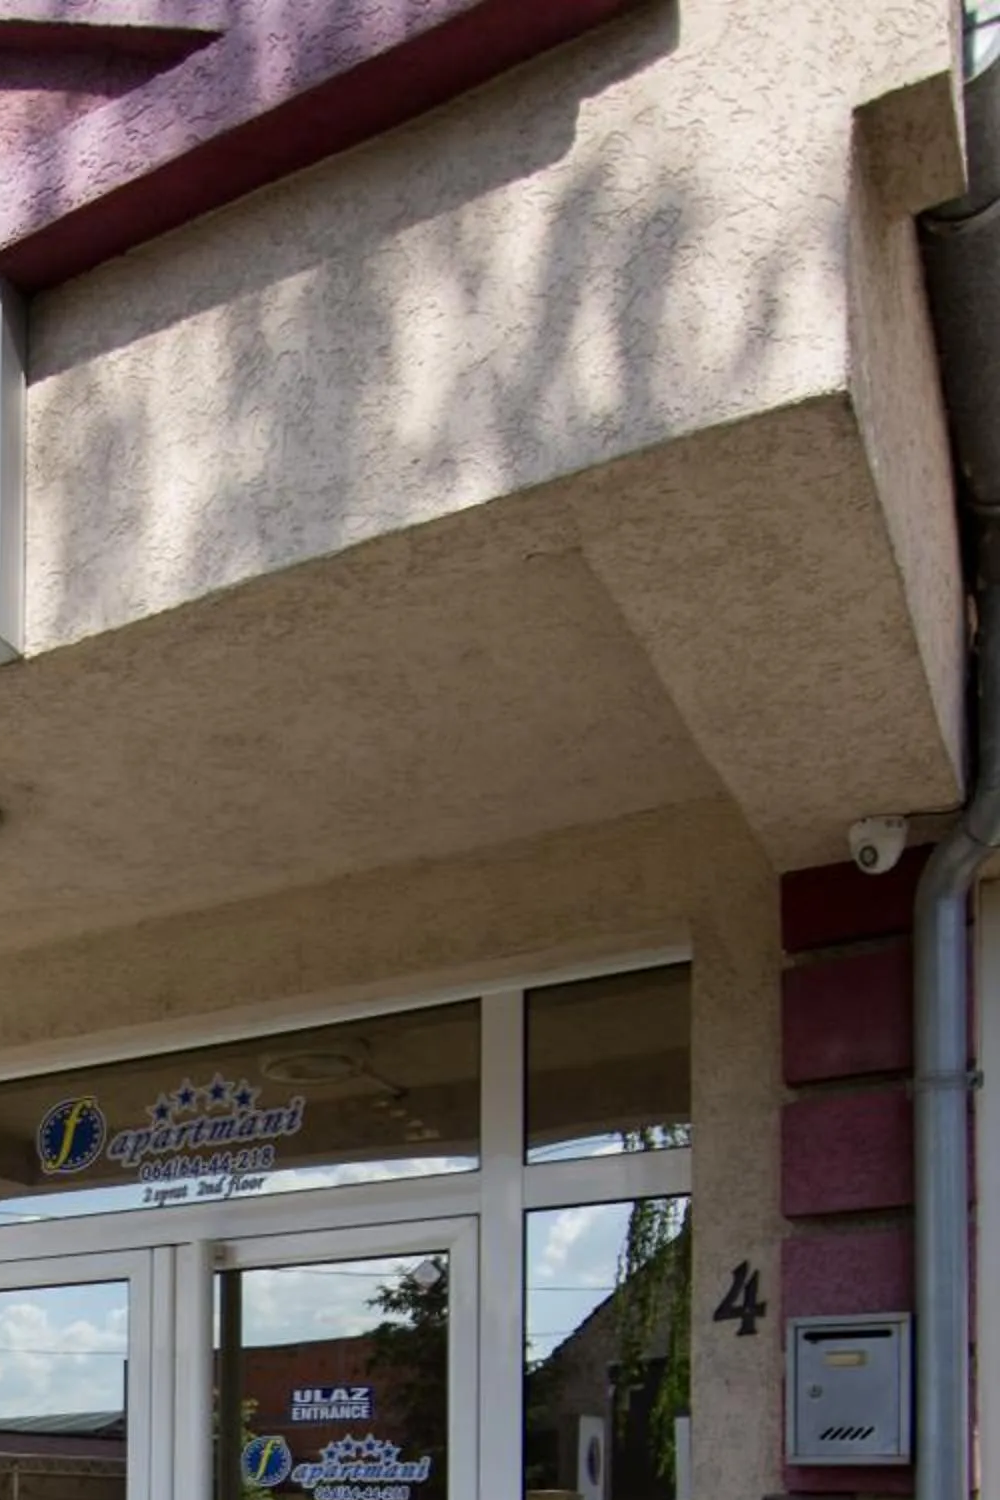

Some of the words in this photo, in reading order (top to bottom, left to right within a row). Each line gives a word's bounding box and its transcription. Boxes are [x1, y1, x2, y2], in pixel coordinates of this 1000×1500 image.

[107, 1096, 305, 1167] apartmani
[223, 1175, 266, 1200] floor
[713, 1260, 767, 1336] 4
[293, 1387, 370, 1403] ULAZ
[292, 1404, 370, 1421] ENTRANCE
